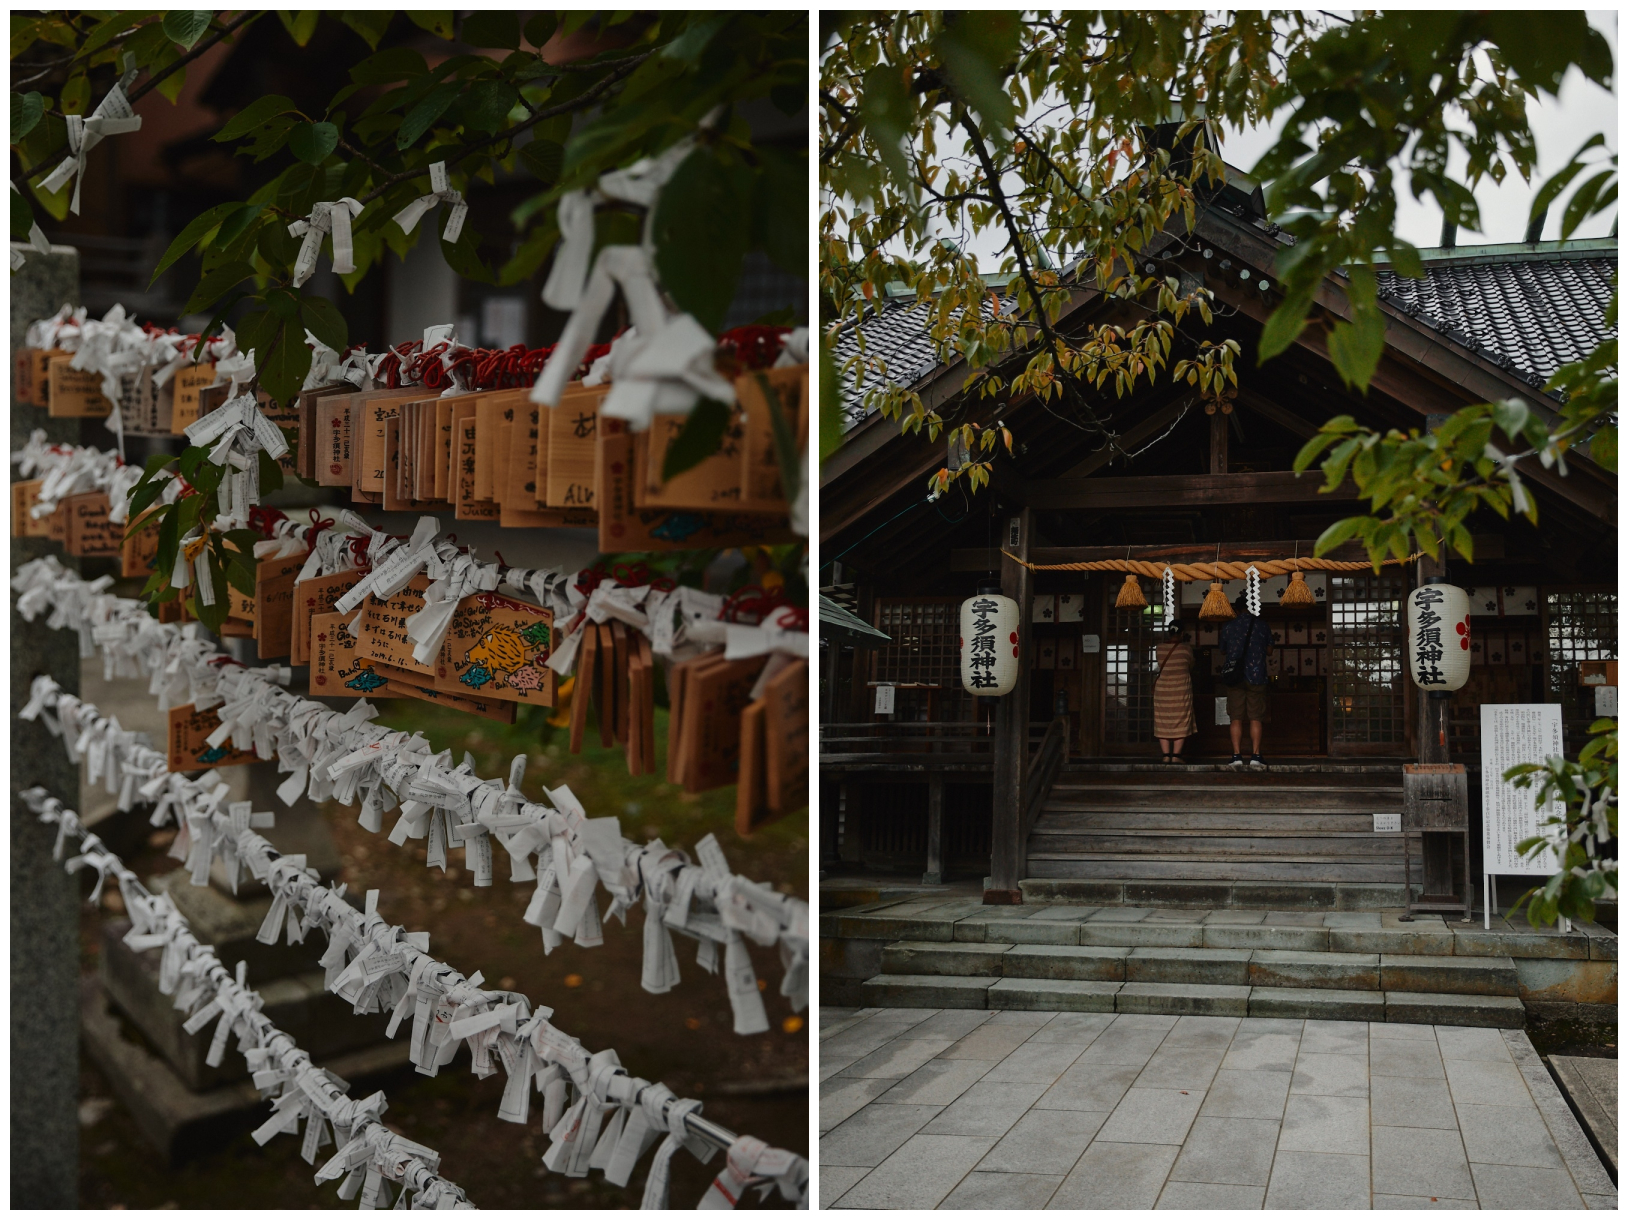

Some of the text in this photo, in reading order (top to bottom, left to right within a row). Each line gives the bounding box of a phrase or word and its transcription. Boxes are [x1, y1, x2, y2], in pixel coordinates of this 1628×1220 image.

[969, 598, 999, 689] 宇多須神社
[1414, 588, 1447, 685] 宇多須神社
